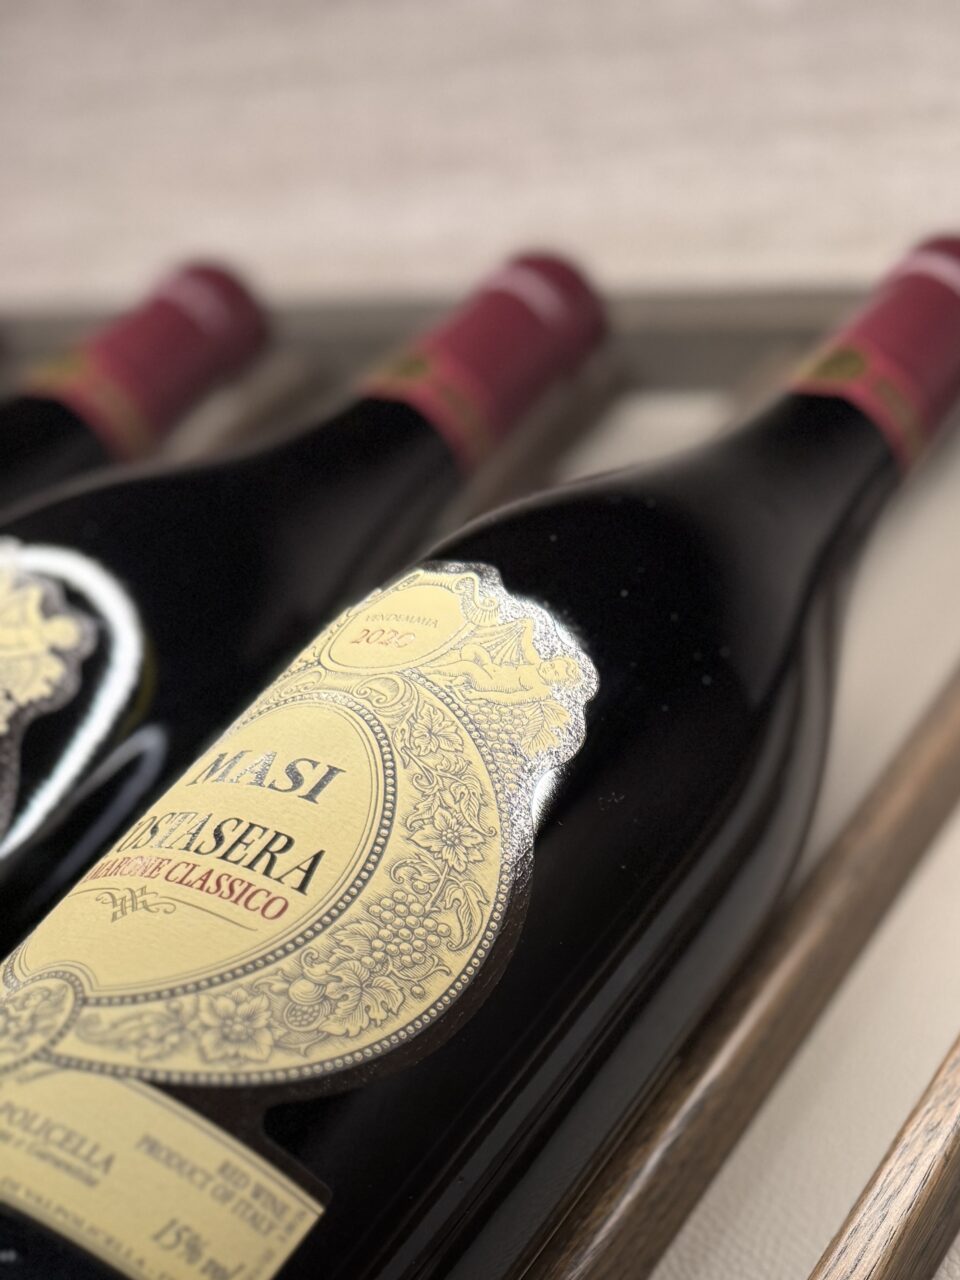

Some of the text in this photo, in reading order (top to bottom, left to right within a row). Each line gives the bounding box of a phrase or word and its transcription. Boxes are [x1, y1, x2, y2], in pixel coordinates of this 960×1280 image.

[187, 749, 346, 805] MASI
[164, 861, 290, 921] CLASSICO
[136, 1134, 214, 1191] PRODUCT
[211, 1184, 236, 1207] OF
[231, 1198, 277, 1238] ITALY
[218, 1160, 290, 1221] RED WINE
[151, 1217, 208, 1265] 15%
